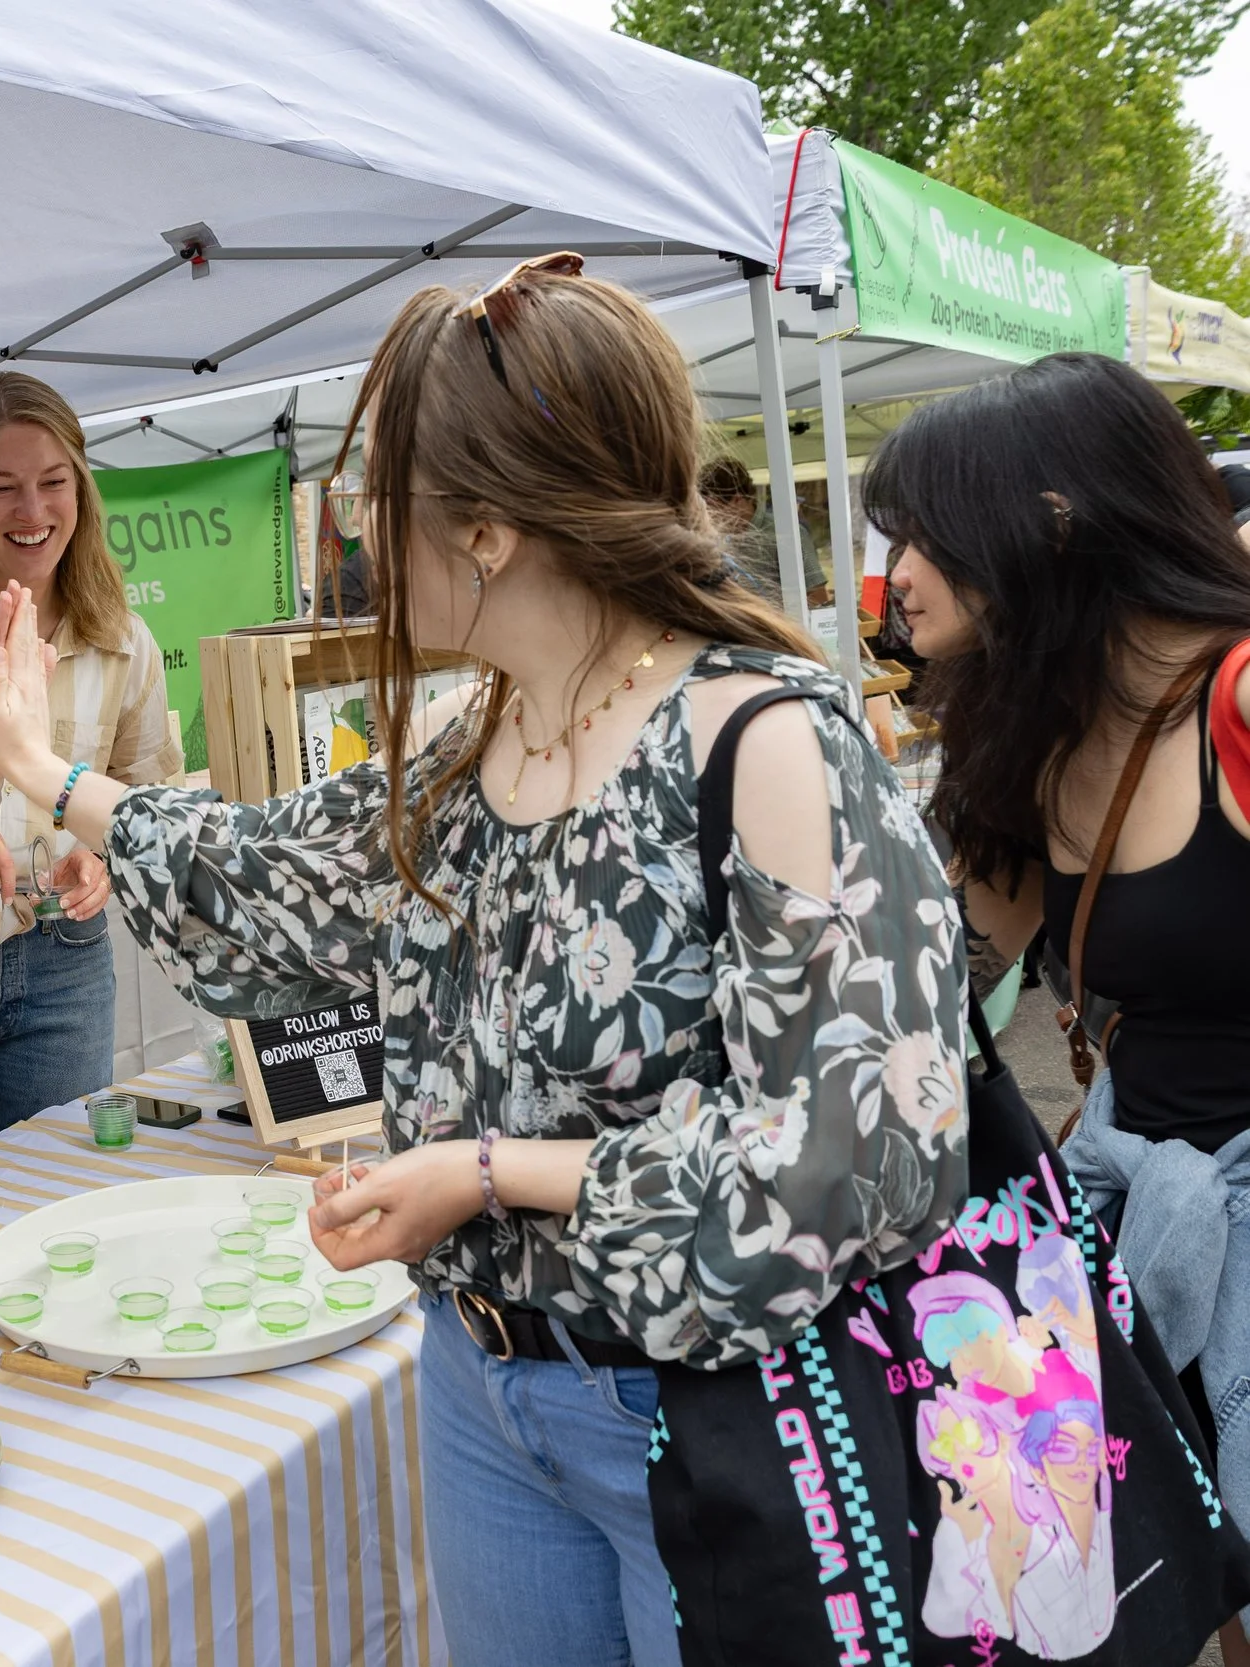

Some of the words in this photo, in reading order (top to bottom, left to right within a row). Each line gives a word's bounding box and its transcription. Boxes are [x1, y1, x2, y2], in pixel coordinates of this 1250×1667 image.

[1022, 245, 1072, 317] Bars
[930, 292, 952, 335] 20g
[953, 299, 994, 338] Protein.
[106, 500, 232, 573] gains
[273, 466, 286, 614] @elevatedgains
[126, 579, 166, 606] ars
[163, 649, 188, 671] h!t.
[313, 736, 328, 779] tory
[283, 1009, 340, 1036] FOLLOW
[349, 1003, 371, 1021] US
[261, 1024, 384, 1067] @DRINKSHORTSTO
[1107, 1251, 1135, 1345] WOR
[775, 1407, 848, 1584] WORLD
